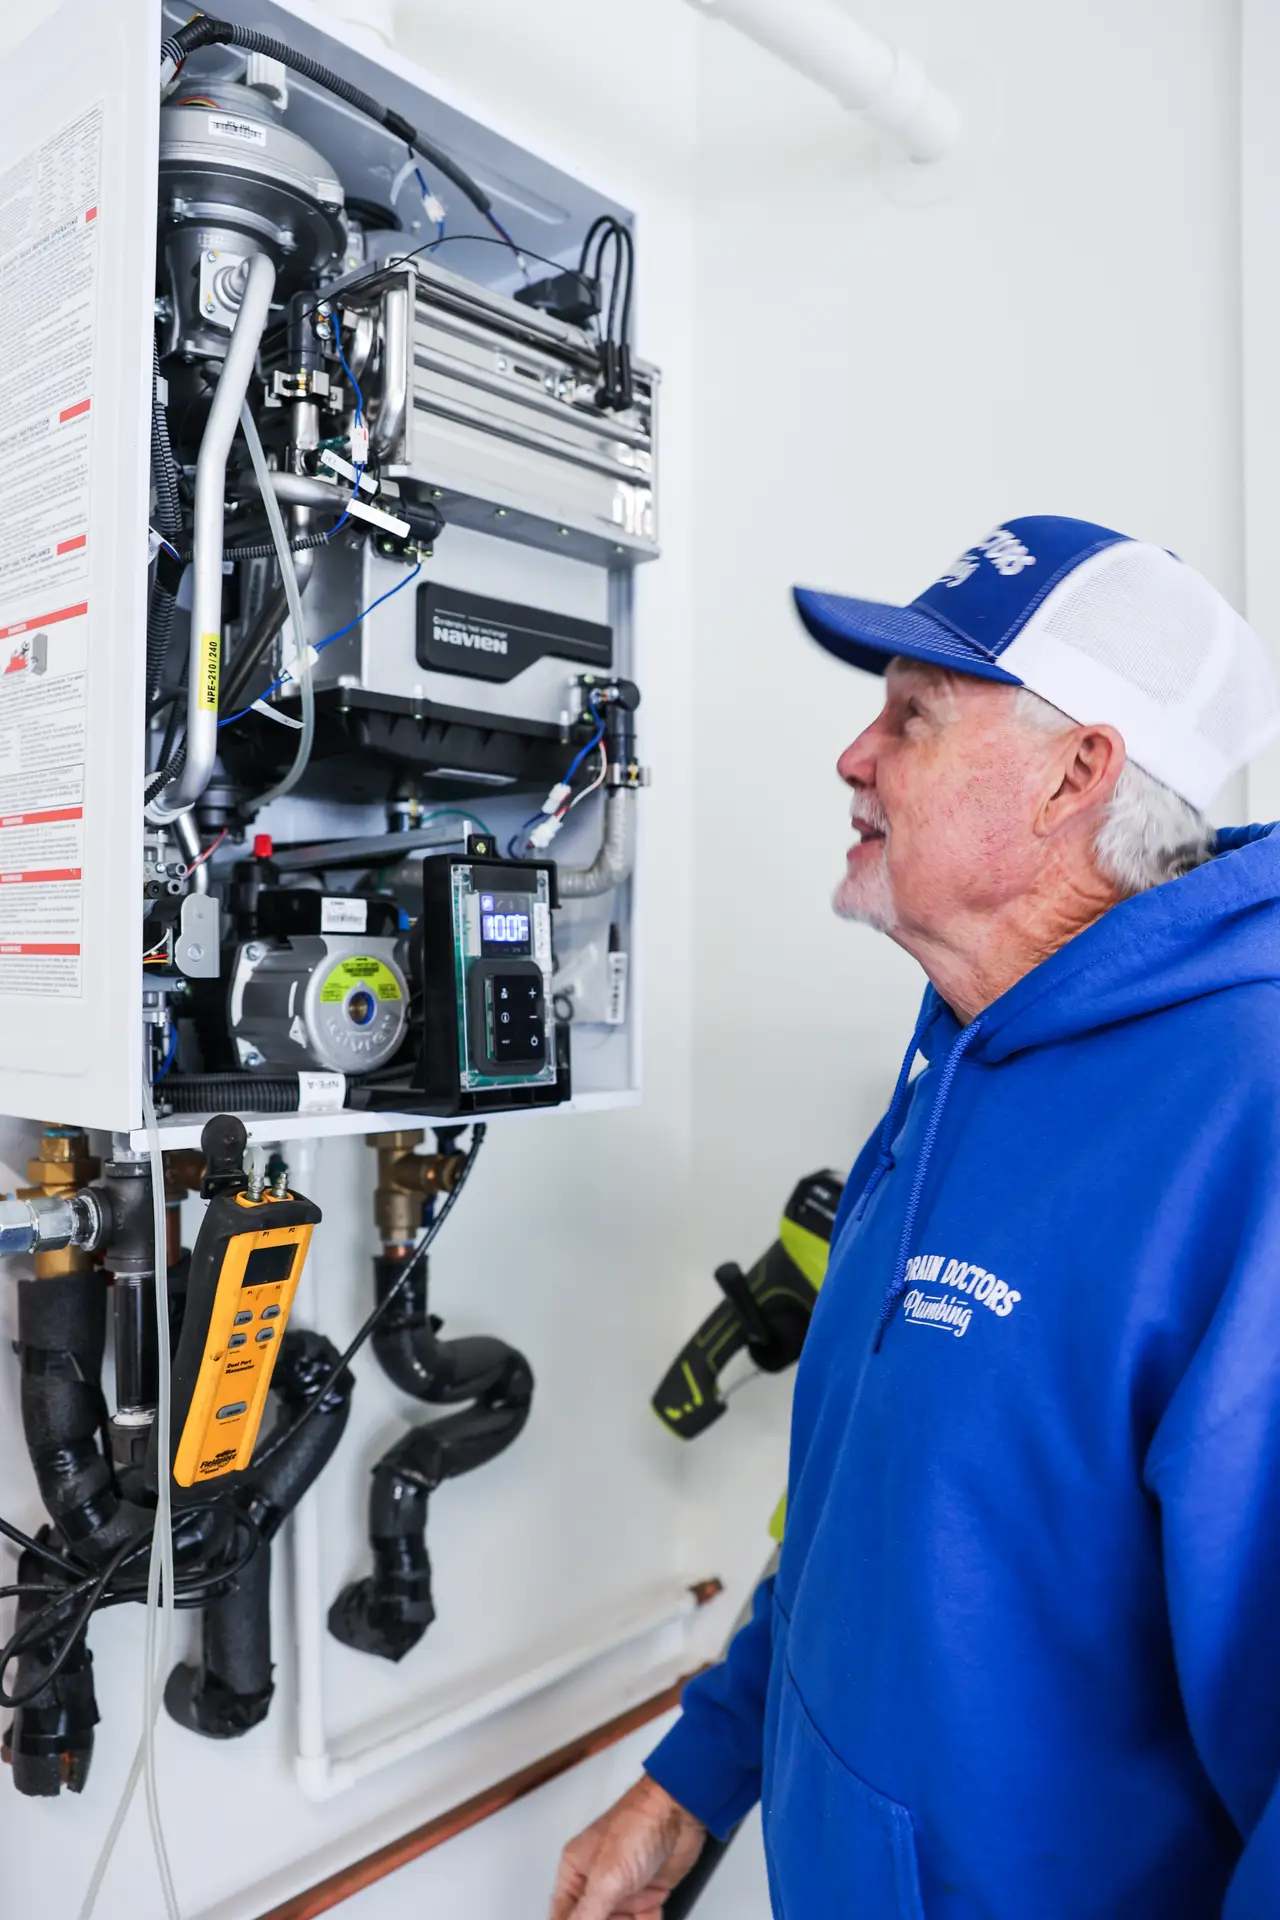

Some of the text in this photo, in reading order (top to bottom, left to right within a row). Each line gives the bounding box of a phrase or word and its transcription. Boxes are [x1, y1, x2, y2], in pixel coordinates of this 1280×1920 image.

[207, 641, 218, 704] NPE-210/240
[903, 1289, 973, 1338] Plumbing
[940, 1258, 1022, 1317] DOCTORS
[226, 1361, 240, 1369] Dual
